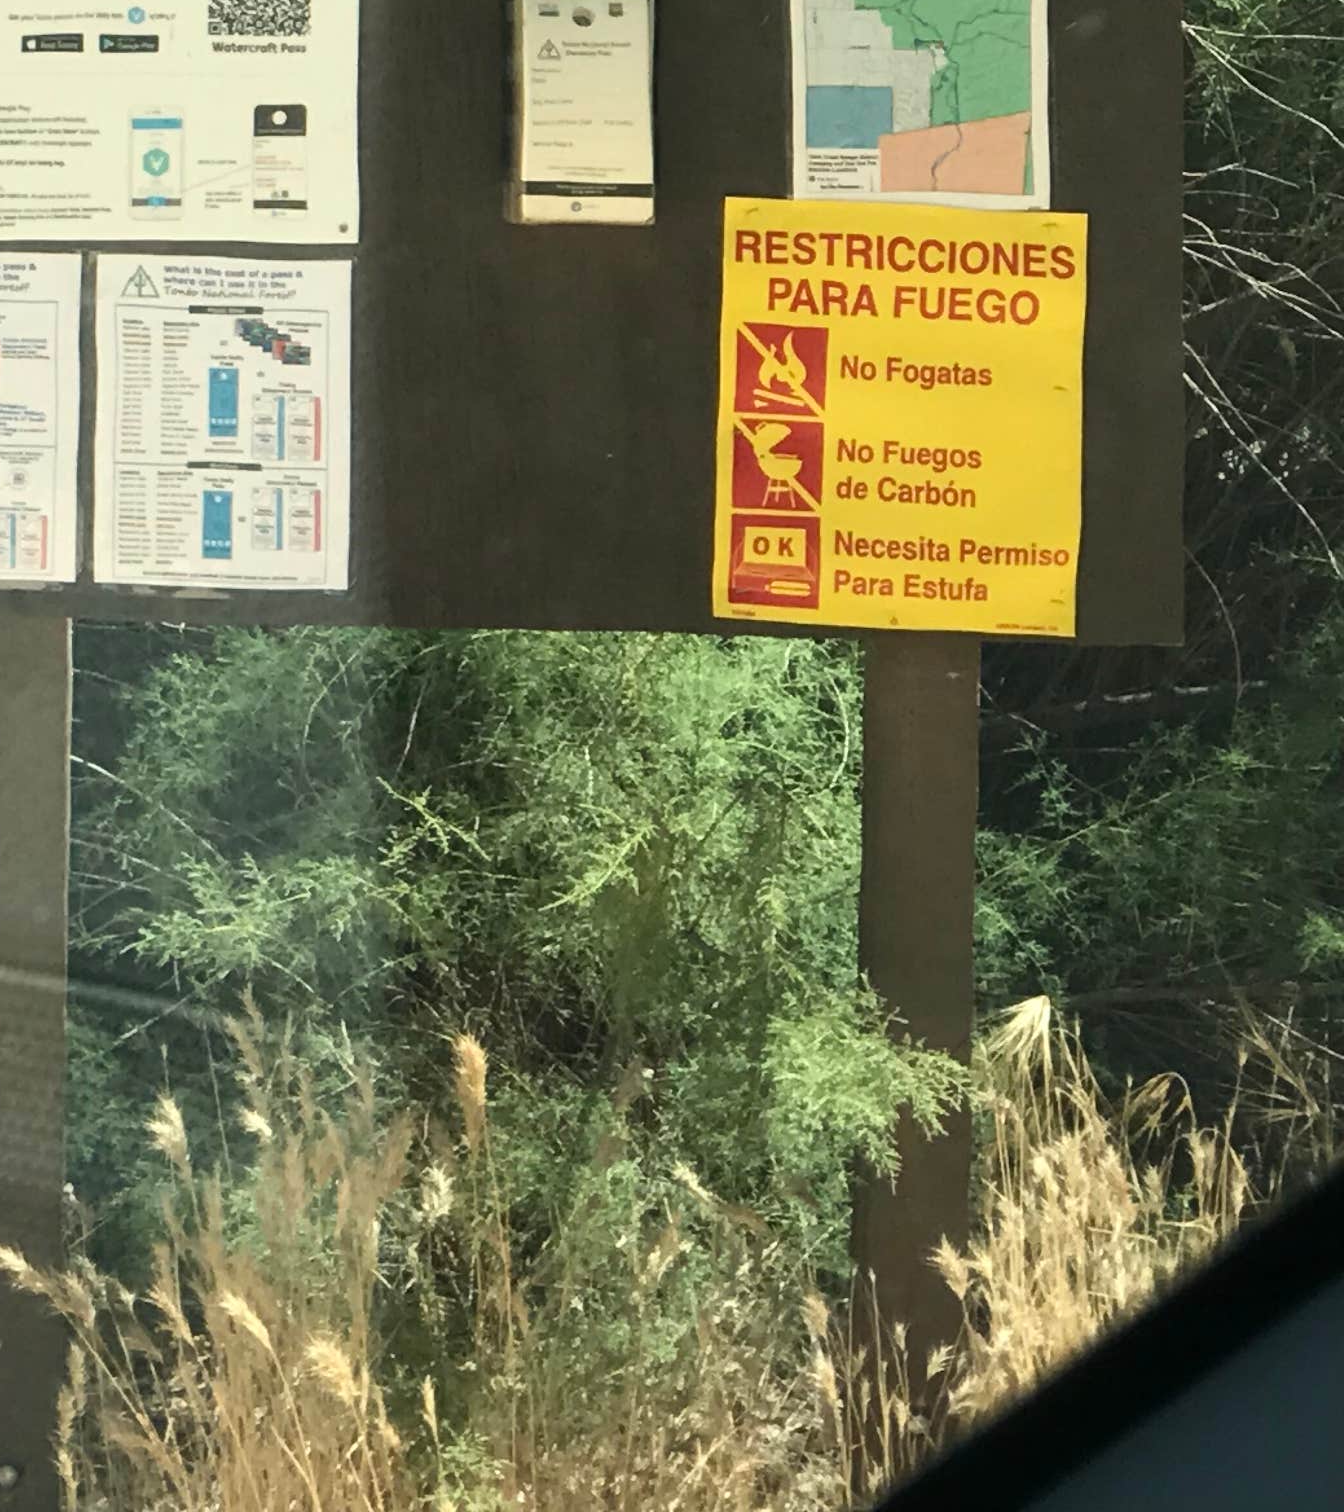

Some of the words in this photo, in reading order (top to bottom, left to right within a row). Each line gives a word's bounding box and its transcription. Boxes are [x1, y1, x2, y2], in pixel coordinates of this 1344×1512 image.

[213, 42, 276, 55] Watercraft
[280, 42, 307, 55] Pass
[735, 230, 1075, 279] RESTRICCIONES
[768, 278, 877, 316] PARA
[894, 286, 1039, 325] FUEGO
[841, 355, 876, 380] No
[886, 357, 992, 390] Fogatas
[837, 439, 874, 463] No
[883, 441, 982, 473] Fuegos
[836, 476, 868, 500] de
[877, 477, 975, 507] Carbón
[834, 530, 950, 562] Necesita
[960, 539, 1069, 566] Permiso
[834, 569, 893, 596] Para
[904, 574, 987, 601] Estufa
